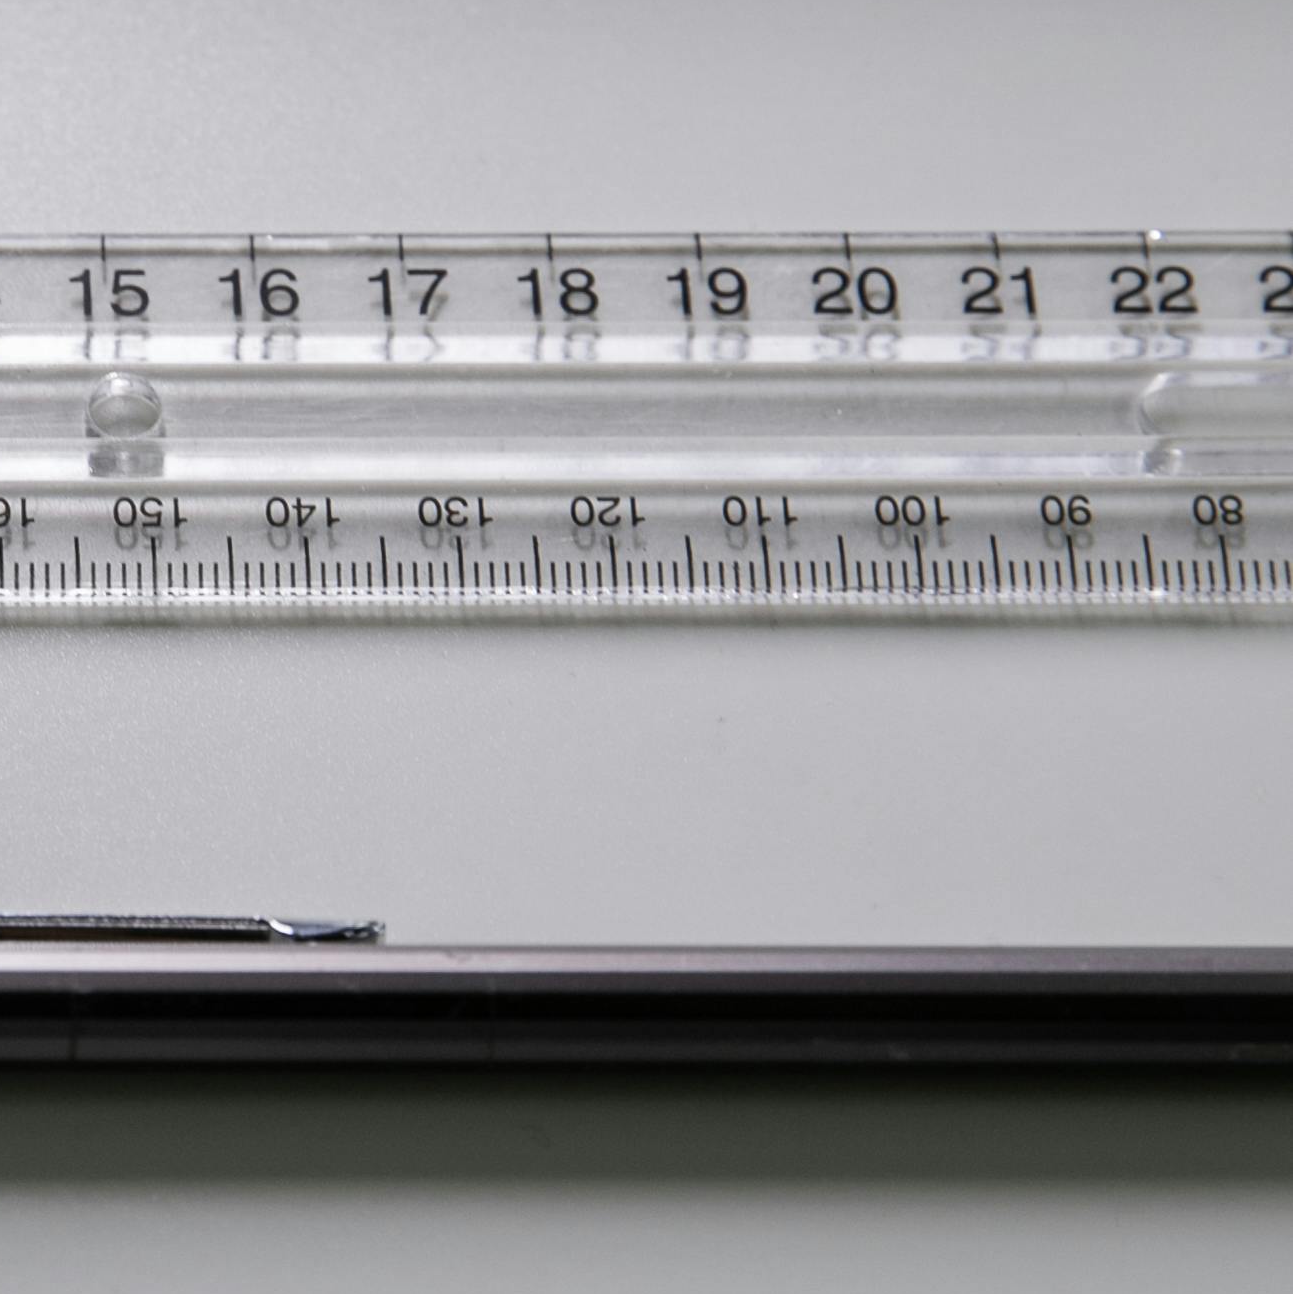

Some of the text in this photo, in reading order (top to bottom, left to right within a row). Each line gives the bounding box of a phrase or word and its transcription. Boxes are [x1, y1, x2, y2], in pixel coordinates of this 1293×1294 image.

[68, 269, 150, 317] 15
[218, 269, 300, 317] 16
[367, 269, 448, 317] 17
[517, 268, 600, 316] 18
[667, 268, 748, 316] 19
[812, 267, 898, 315] 20
[961, 267, 1037, 315] 21
[1110, 266, 1198, 313] 22
[1259, 265, 1293, 313] 2
[113, 497, 187, 528] 150
[265, 497, 340, 528] 140
[418, 497, 492, 528] 130
[570, 496, 645, 527] 120
[722, 496, 797, 527] 110
[874, 496, 949, 527] 100
[1040, 495, 1092, 526] 90
[1192, 495, 1243, 526] 80
